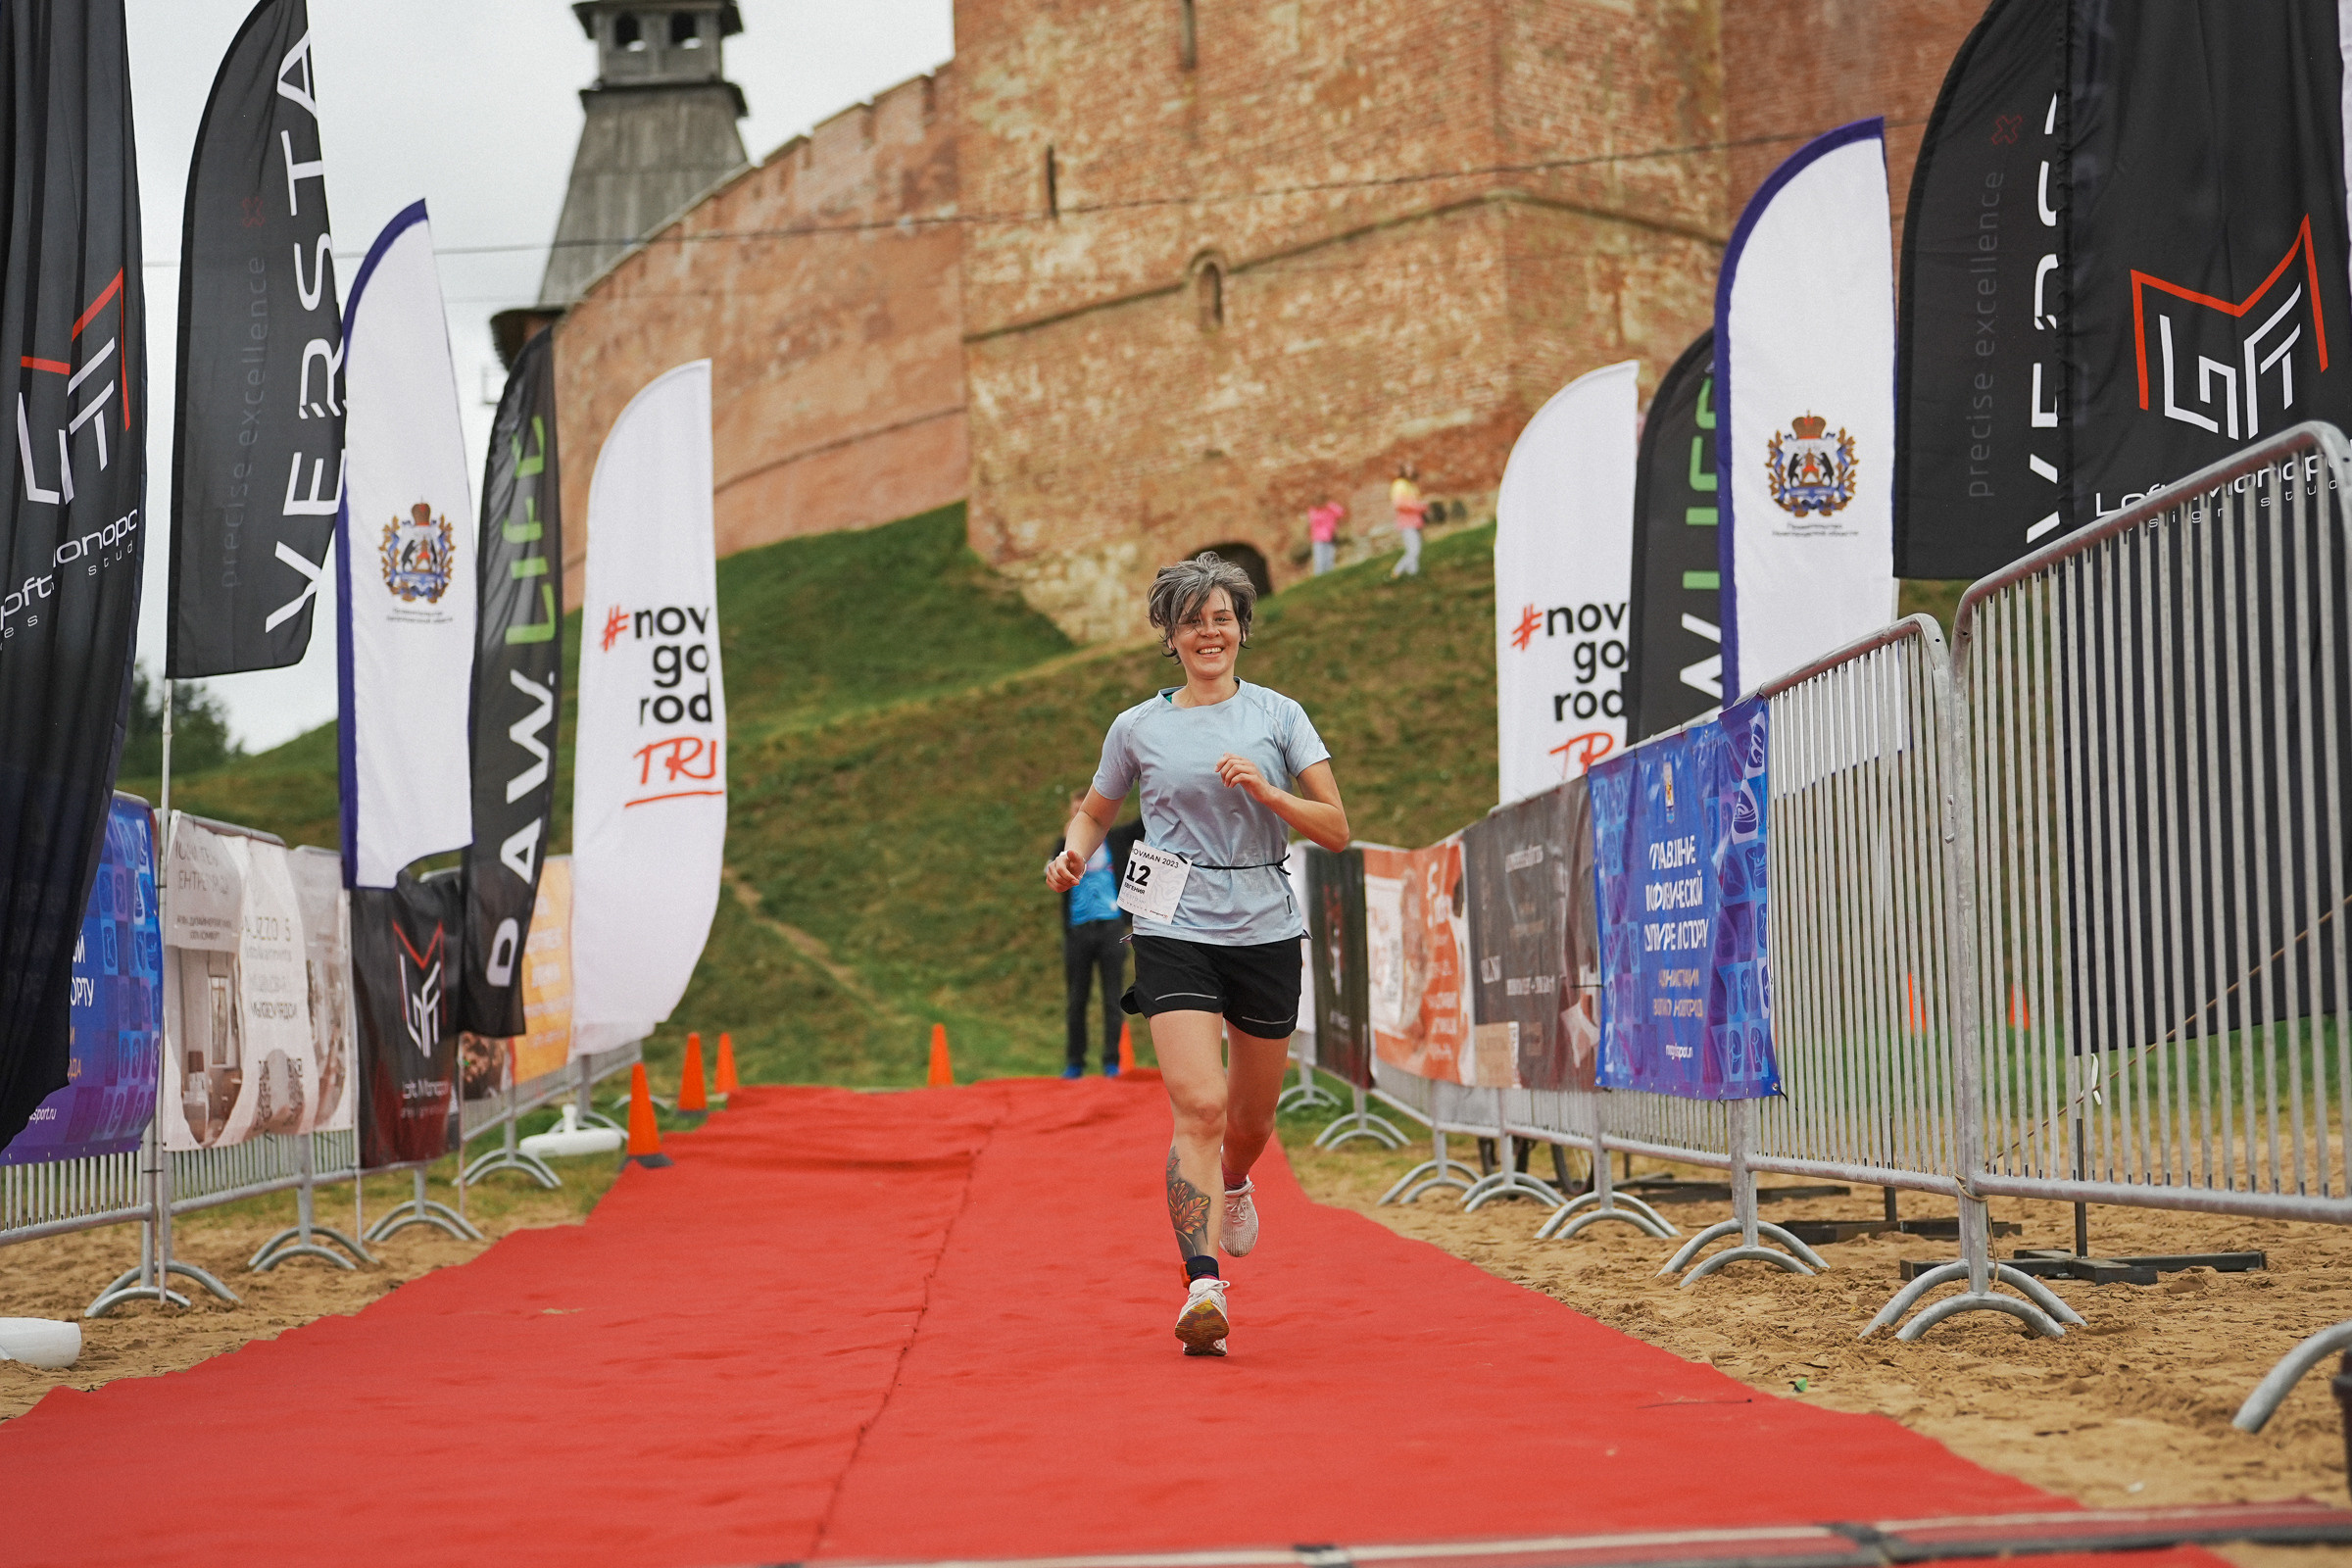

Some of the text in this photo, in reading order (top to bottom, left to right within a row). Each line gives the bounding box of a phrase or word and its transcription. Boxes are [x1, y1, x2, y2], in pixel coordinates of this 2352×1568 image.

[265, 28, 347, 633] VERSTA
[1966, 171, 2004, 498] precise excellence
[221, 256, 268, 588] precise excellence
[601, 605, 710, 653] #nov
[1512, 604, 1628, 652] #nov
[1574, 639, 1627, 684] go
[639, 677, 712, 726] rod
[633, 737, 717, 785] TRI
[1126, 859, 1152, 887] 12
[1131, 847, 1180, 869] OVMAN 2023
